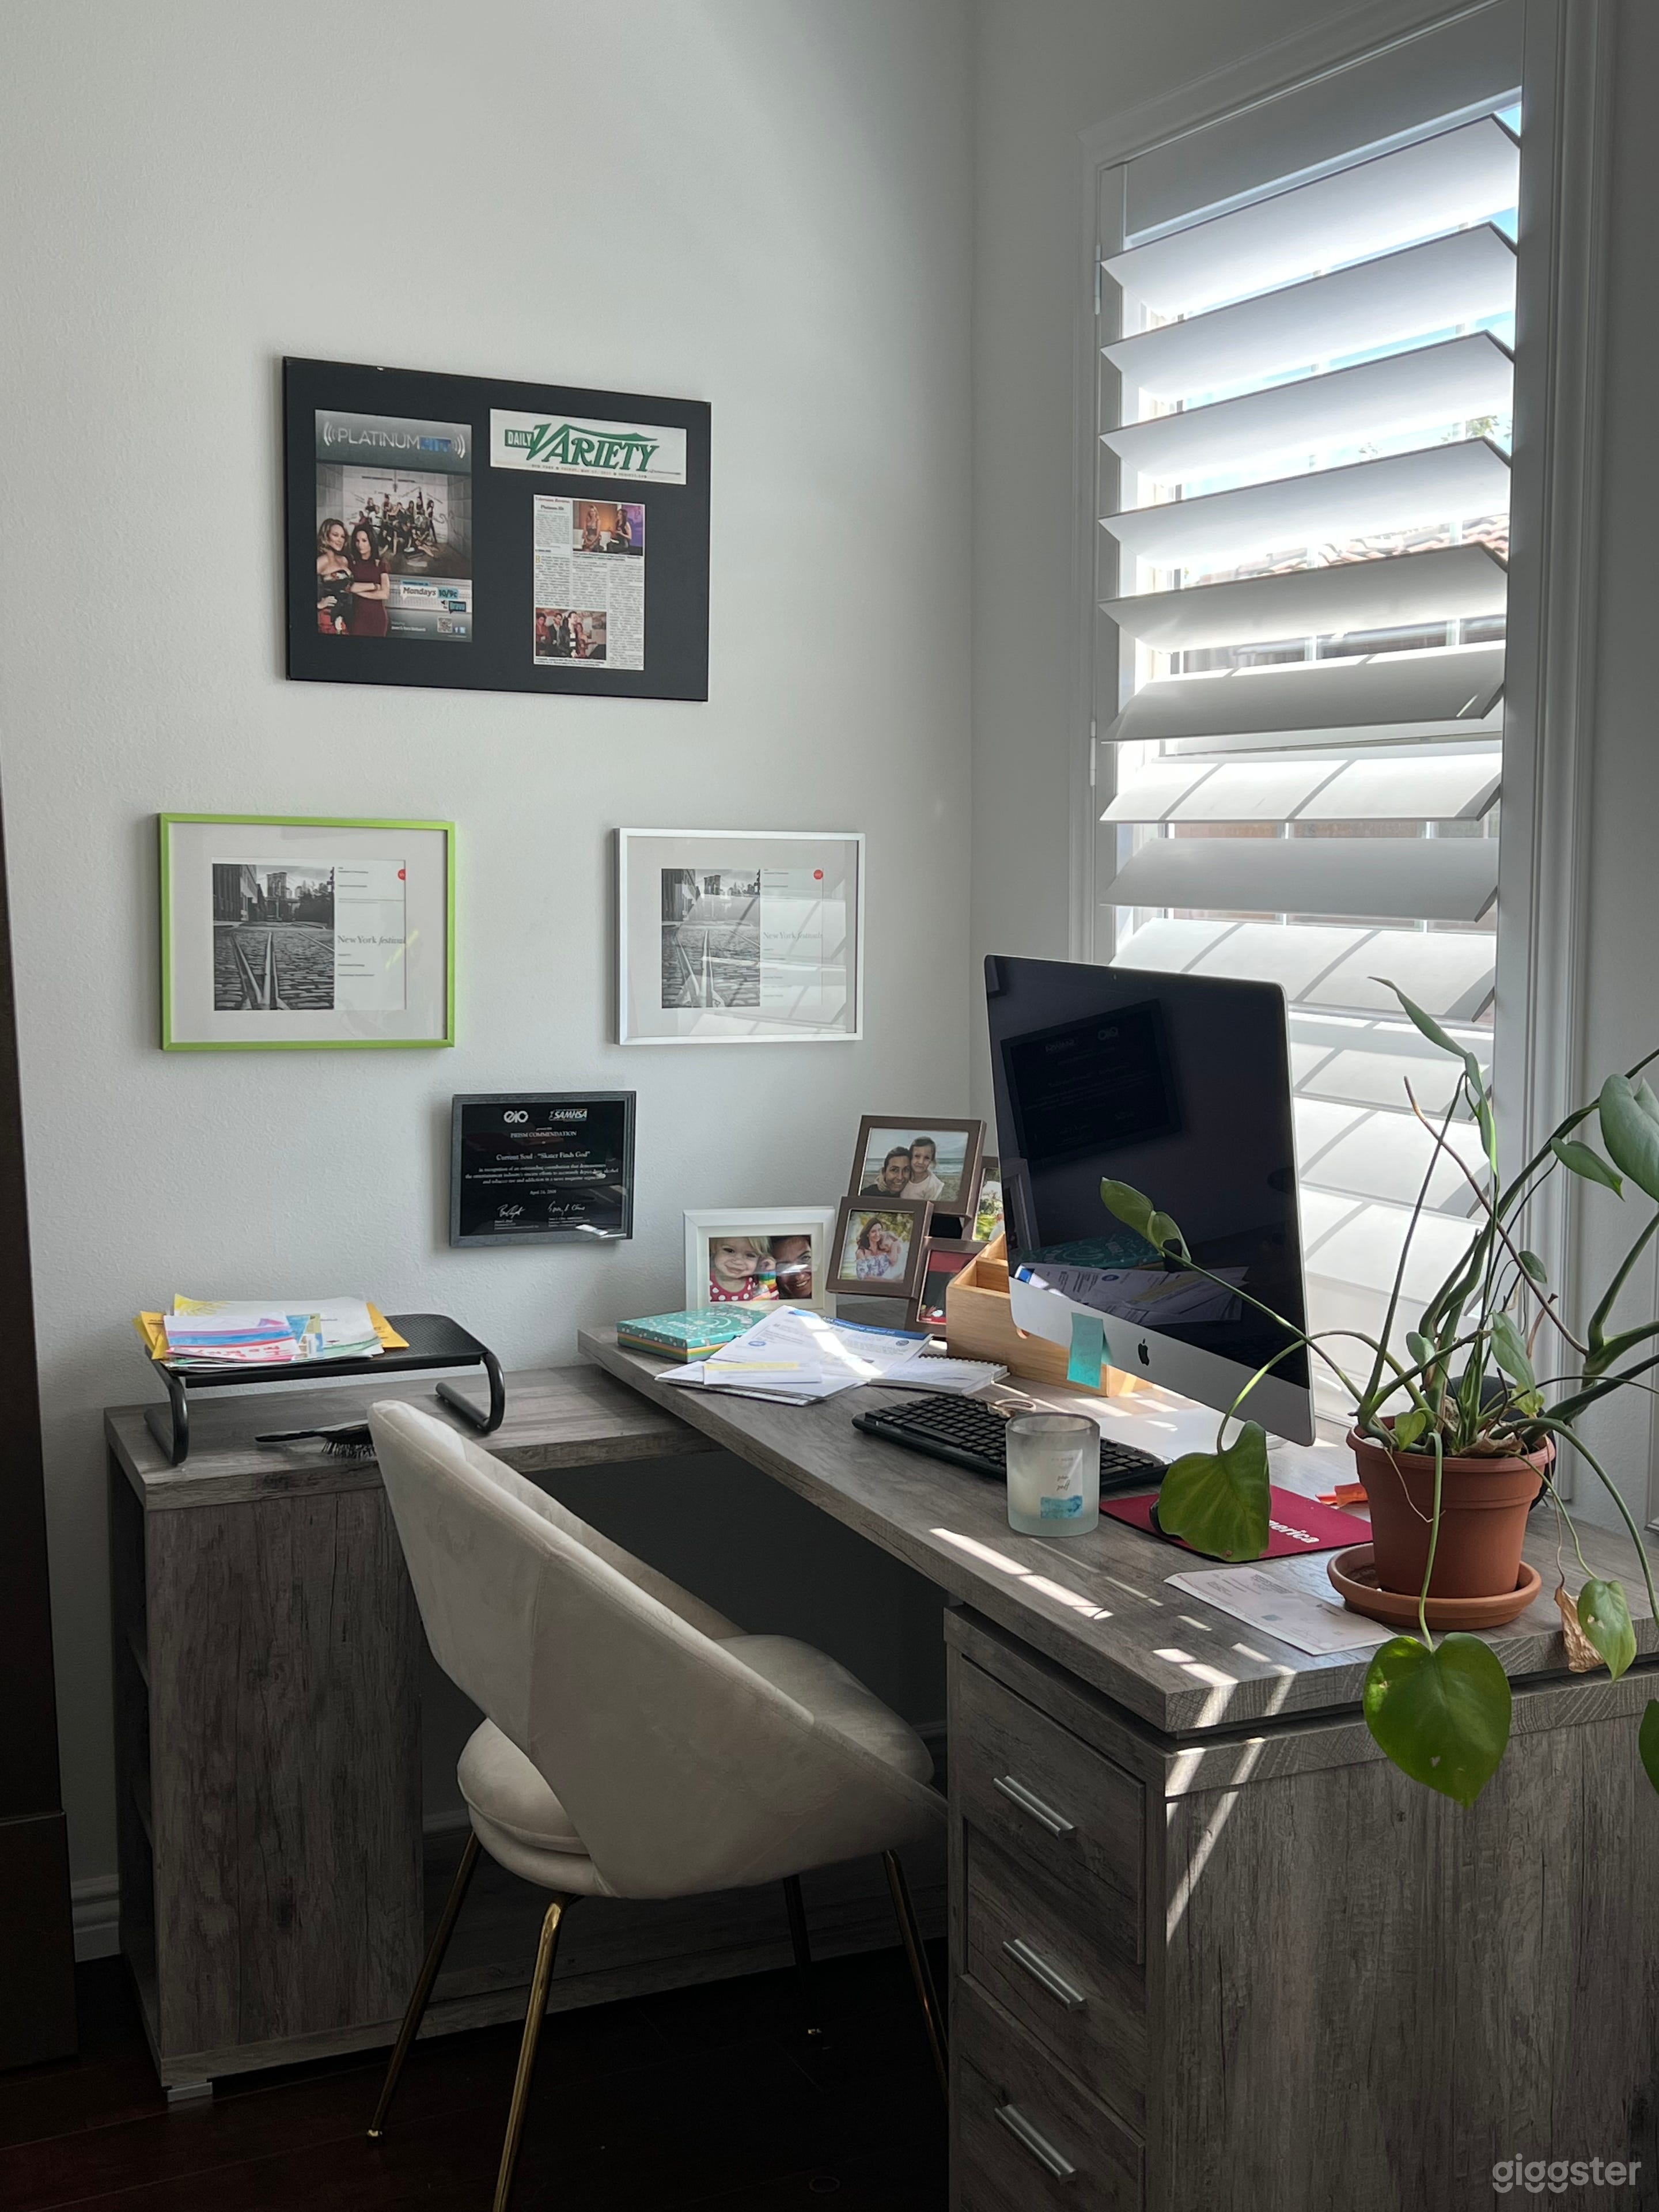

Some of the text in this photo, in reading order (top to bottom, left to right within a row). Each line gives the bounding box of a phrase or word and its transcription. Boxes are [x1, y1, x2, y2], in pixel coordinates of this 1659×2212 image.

[337, 429, 420, 449] PLATINUM
[507, 431, 533, 447] DAILY
[527, 423, 660, 472] VARIETY
[403, 587, 437, 597] Mondays
[338, 935, 356, 944] New
[358, 935, 377, 944] York
[1269, 1520, 1320, 1543] merica
